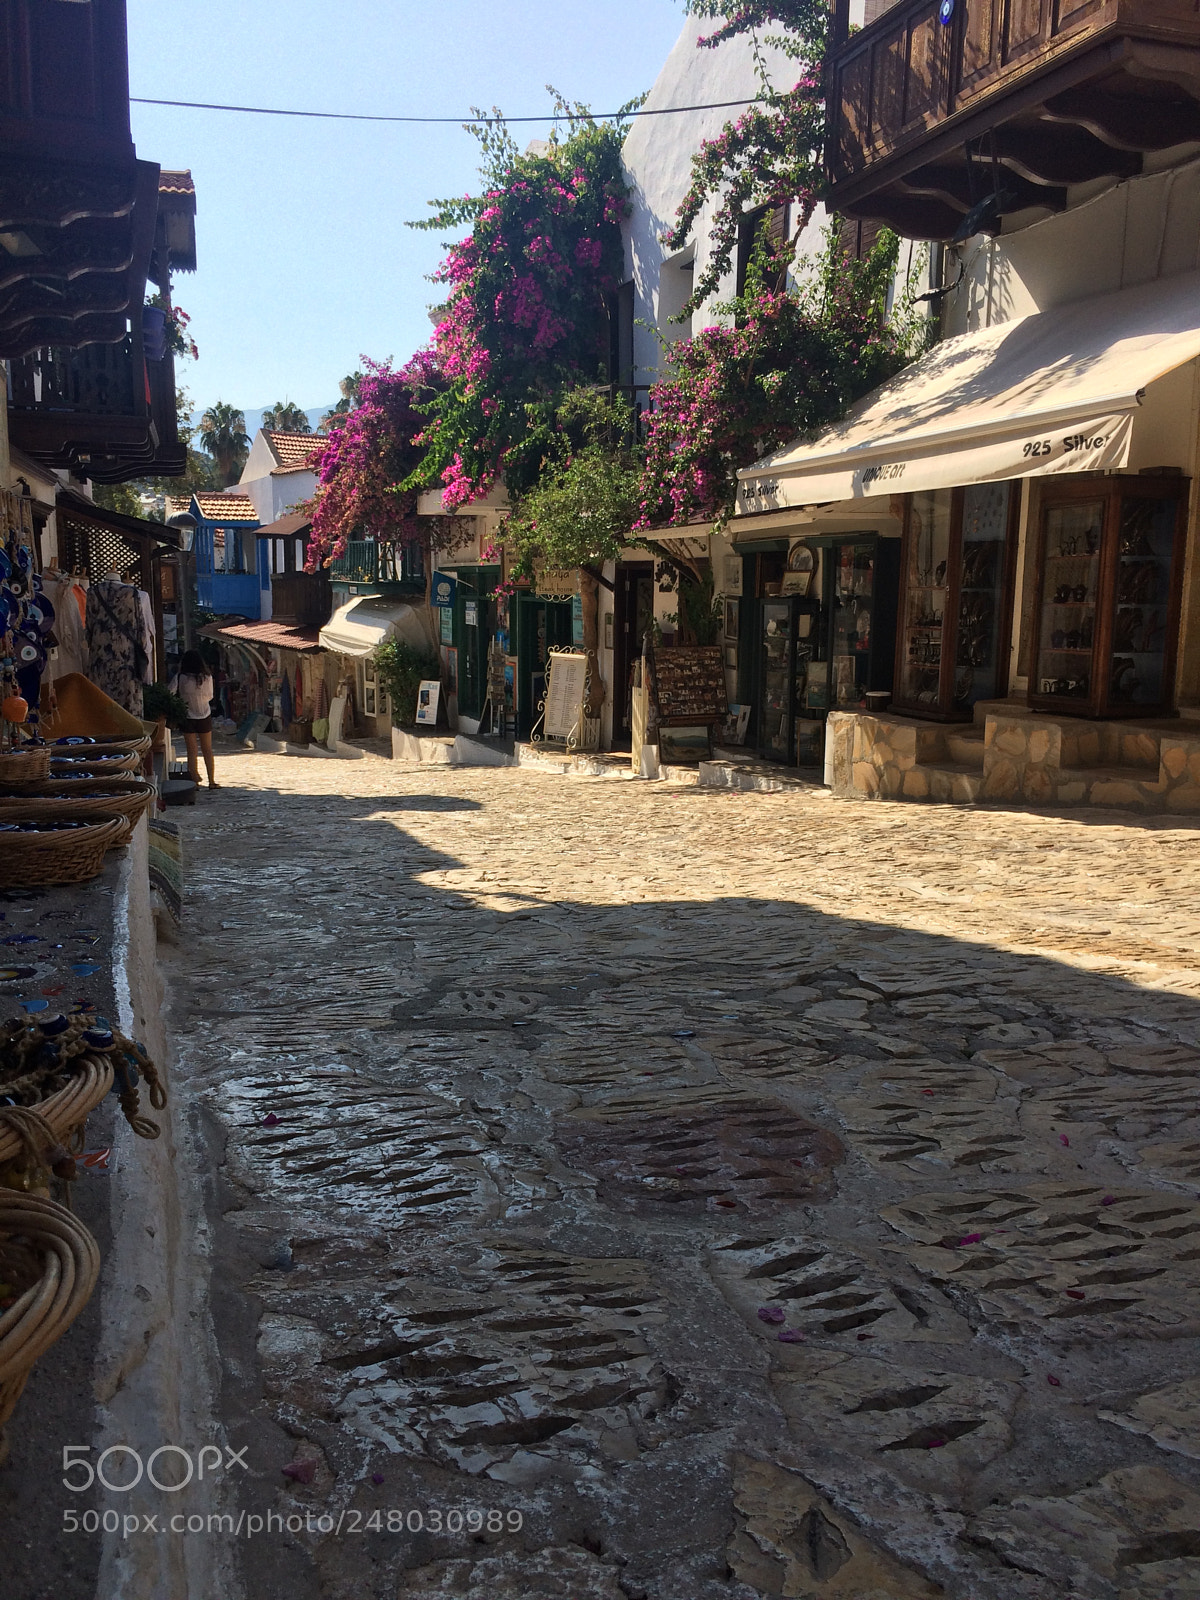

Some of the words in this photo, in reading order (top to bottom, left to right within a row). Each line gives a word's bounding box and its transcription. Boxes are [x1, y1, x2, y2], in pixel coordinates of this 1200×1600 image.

[1022, 440, 1051, 458] 925
[1062, 435, 1111, 453] Silver
[742, 485, 755, 499] 925
[758, 482, 779, 497] Silver
